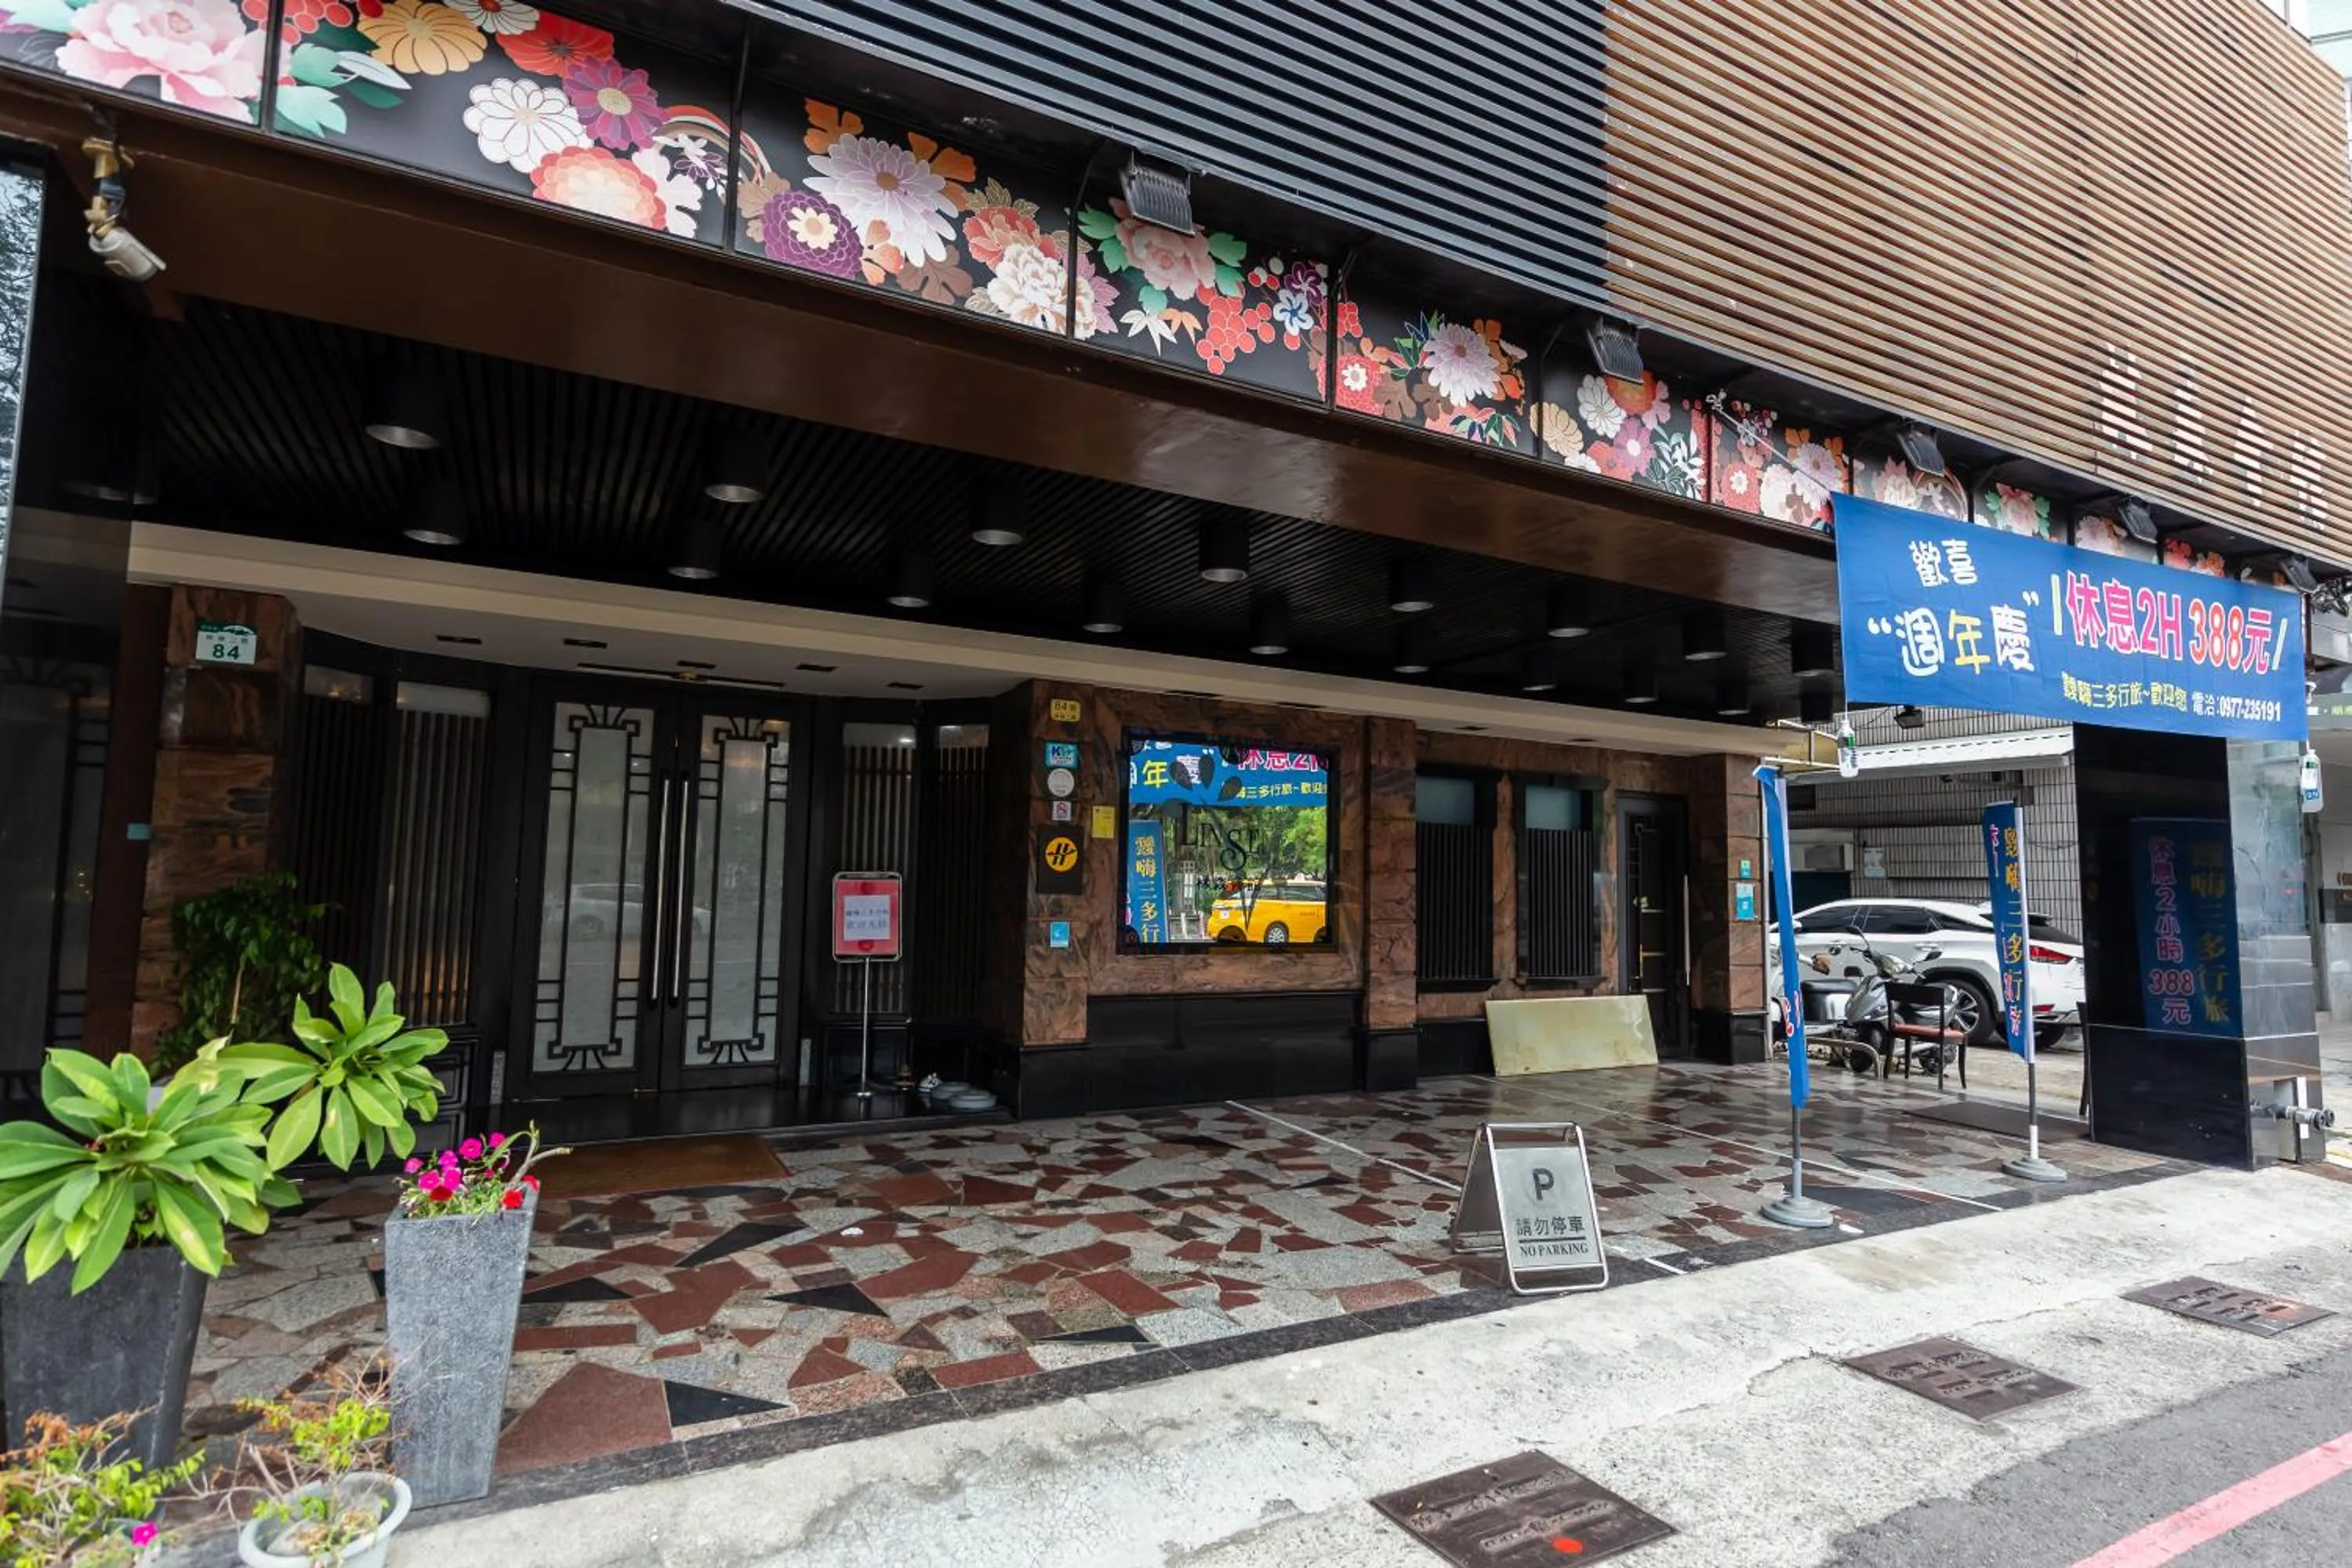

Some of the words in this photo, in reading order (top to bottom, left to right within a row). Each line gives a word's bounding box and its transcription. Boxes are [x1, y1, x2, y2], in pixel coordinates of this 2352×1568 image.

[1908, 539, 1978, 587] 歡喜
[2066, 569, 2183, 662] 休息2H
[2188, 597, 2273, 675] 388元
[212, 644, 240, 660] 84
[1532, 1167, 1555, 1201] P
[1516, 1215, 1586, 1237] 請勿停車
[1519, 1245, 1537, 1258] NO
[1538, 1243, 1589, 1257] PARKING
